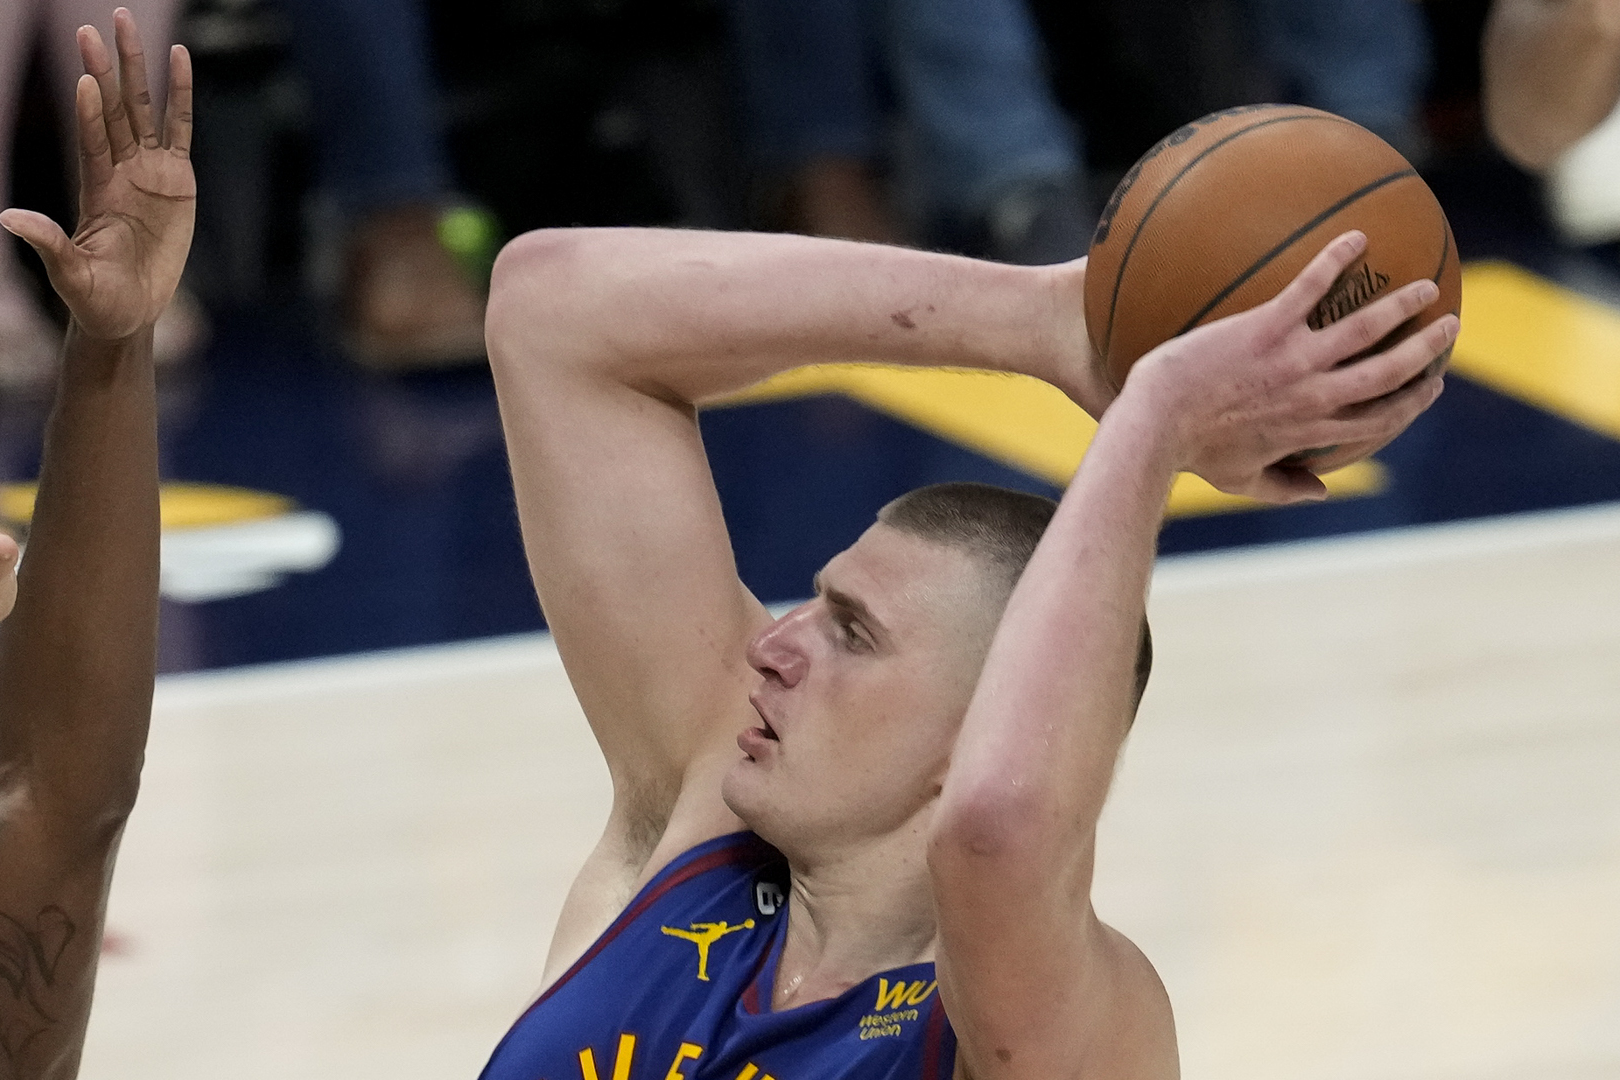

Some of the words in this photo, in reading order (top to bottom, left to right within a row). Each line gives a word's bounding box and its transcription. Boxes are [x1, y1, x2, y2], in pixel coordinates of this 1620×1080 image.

[874, 977, 939, 1012] WU
[858, 1008, 919, 1028] Western
[859, 1023, 902, 1041] Union
